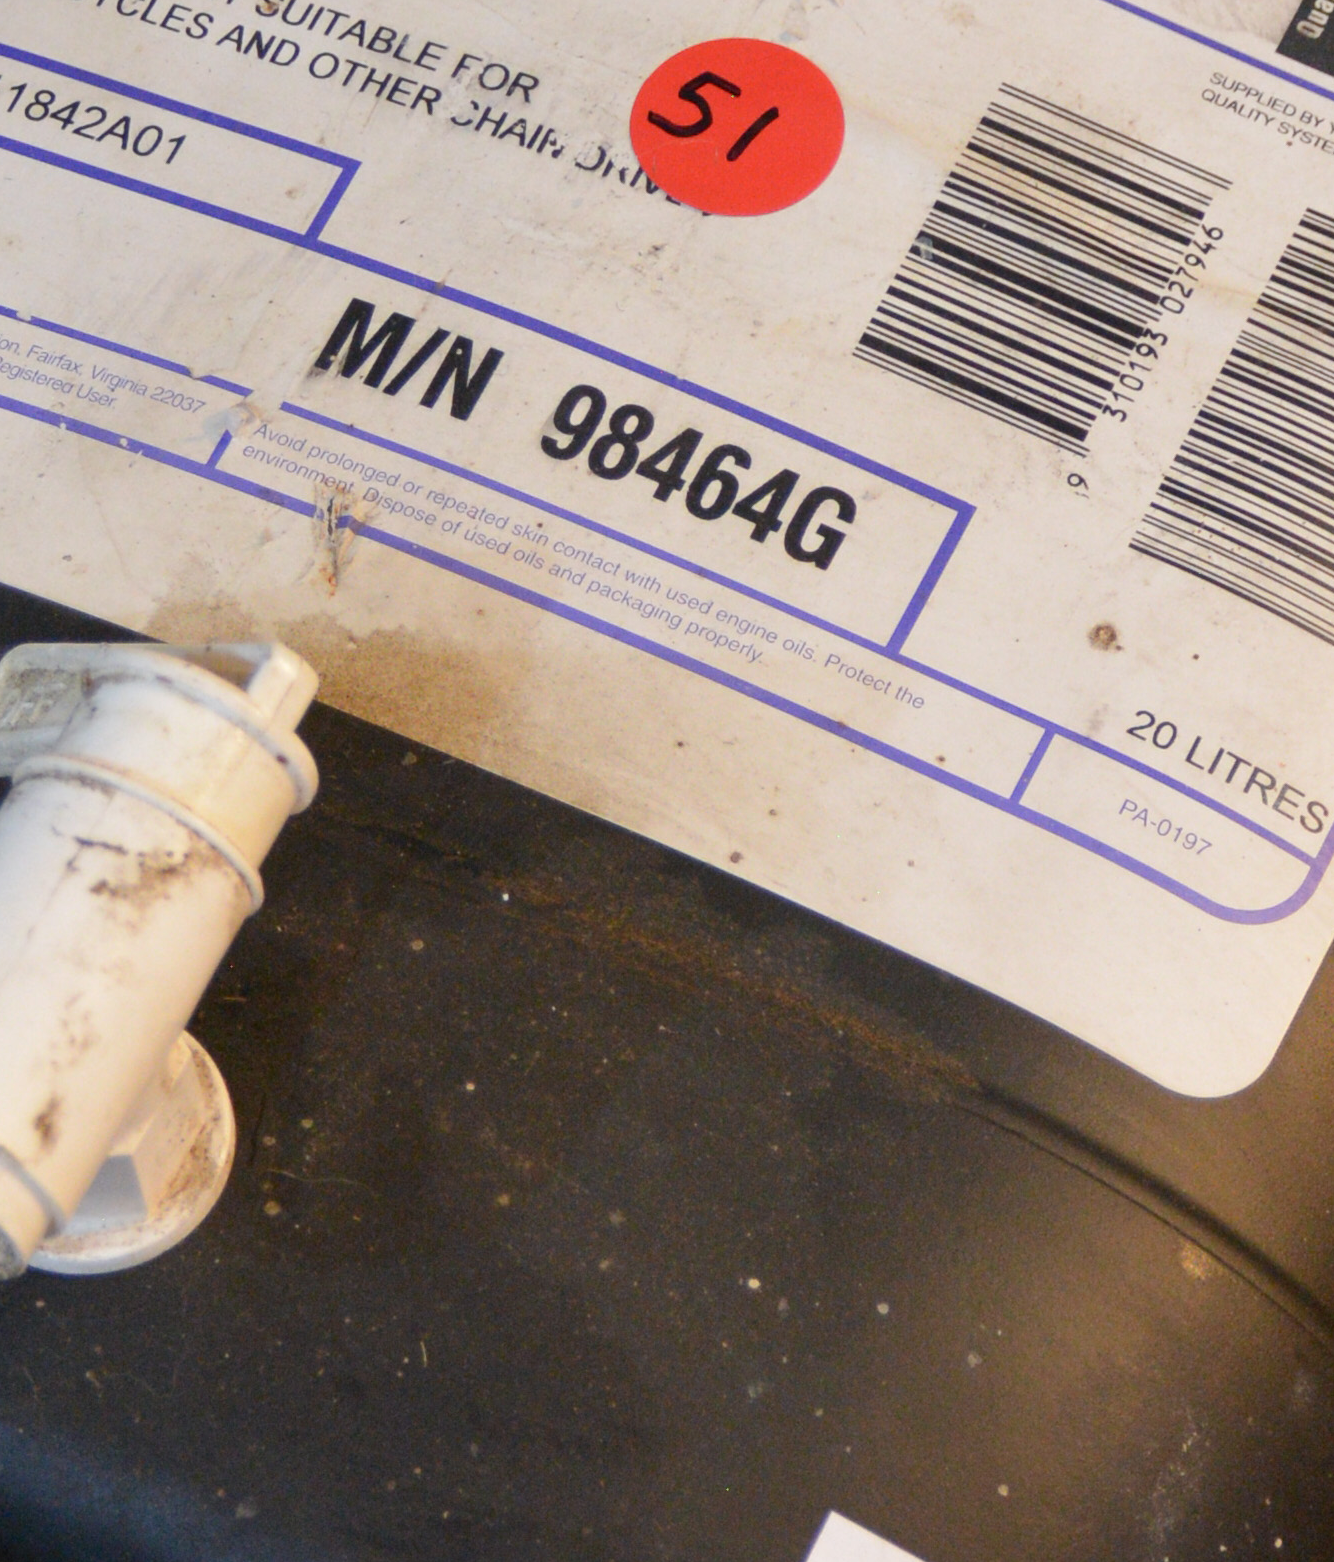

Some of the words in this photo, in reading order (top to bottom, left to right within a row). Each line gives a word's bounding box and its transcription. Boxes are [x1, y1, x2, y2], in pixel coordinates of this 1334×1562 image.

[215, 24, 301, 67] AND
[308, 51, 443, 116] OTHER
[451, 52, 540, 103] FOR
[1200, 88, 1276, 129] QUALITY
[1208, 71, 1297, 118] SUPPLIED
[1299, 109, 1327, 131] BY
[647, 70, 780, 163] 51
[1101, 327, 1169, 424] 310193
[1158, 223, 1225, 315] 027946
[91, 364, 148, 398] Virginia
[149, 385, 206, 415] 22037
[314, 297, 505, 422] M/N
[539, 383, 857, 572] 98464G
[252, 422, 308, 454] Avoid
[307, 445, 402, 488] prolonged
[402, 479, 424, 494] or
[425, 488, 510, 531] repeated
[511, 519, 550, 547] skin
[552, 539, 622, 577] contact
[624, 564, 663, 594] with
[665, 584, 715, 616] used
[715, 608, 780, 644] engine
[823, 652, 893, 695] Protect
[893, 681, 926, 710] the
[362, 487, 438, 527] Dispose
[441, 516, 464, 534] of
[463, 526, 512, 556] used
[512, 545, 546, 571] oils
[548, 560, 587, 588] and
[585, 578, 684, 631] packaging
[1125, 709, 1178, 750] 20
[1184, 735, 1330, 835] LITRES
[1117, 798, 1214, 856] PA-0197
